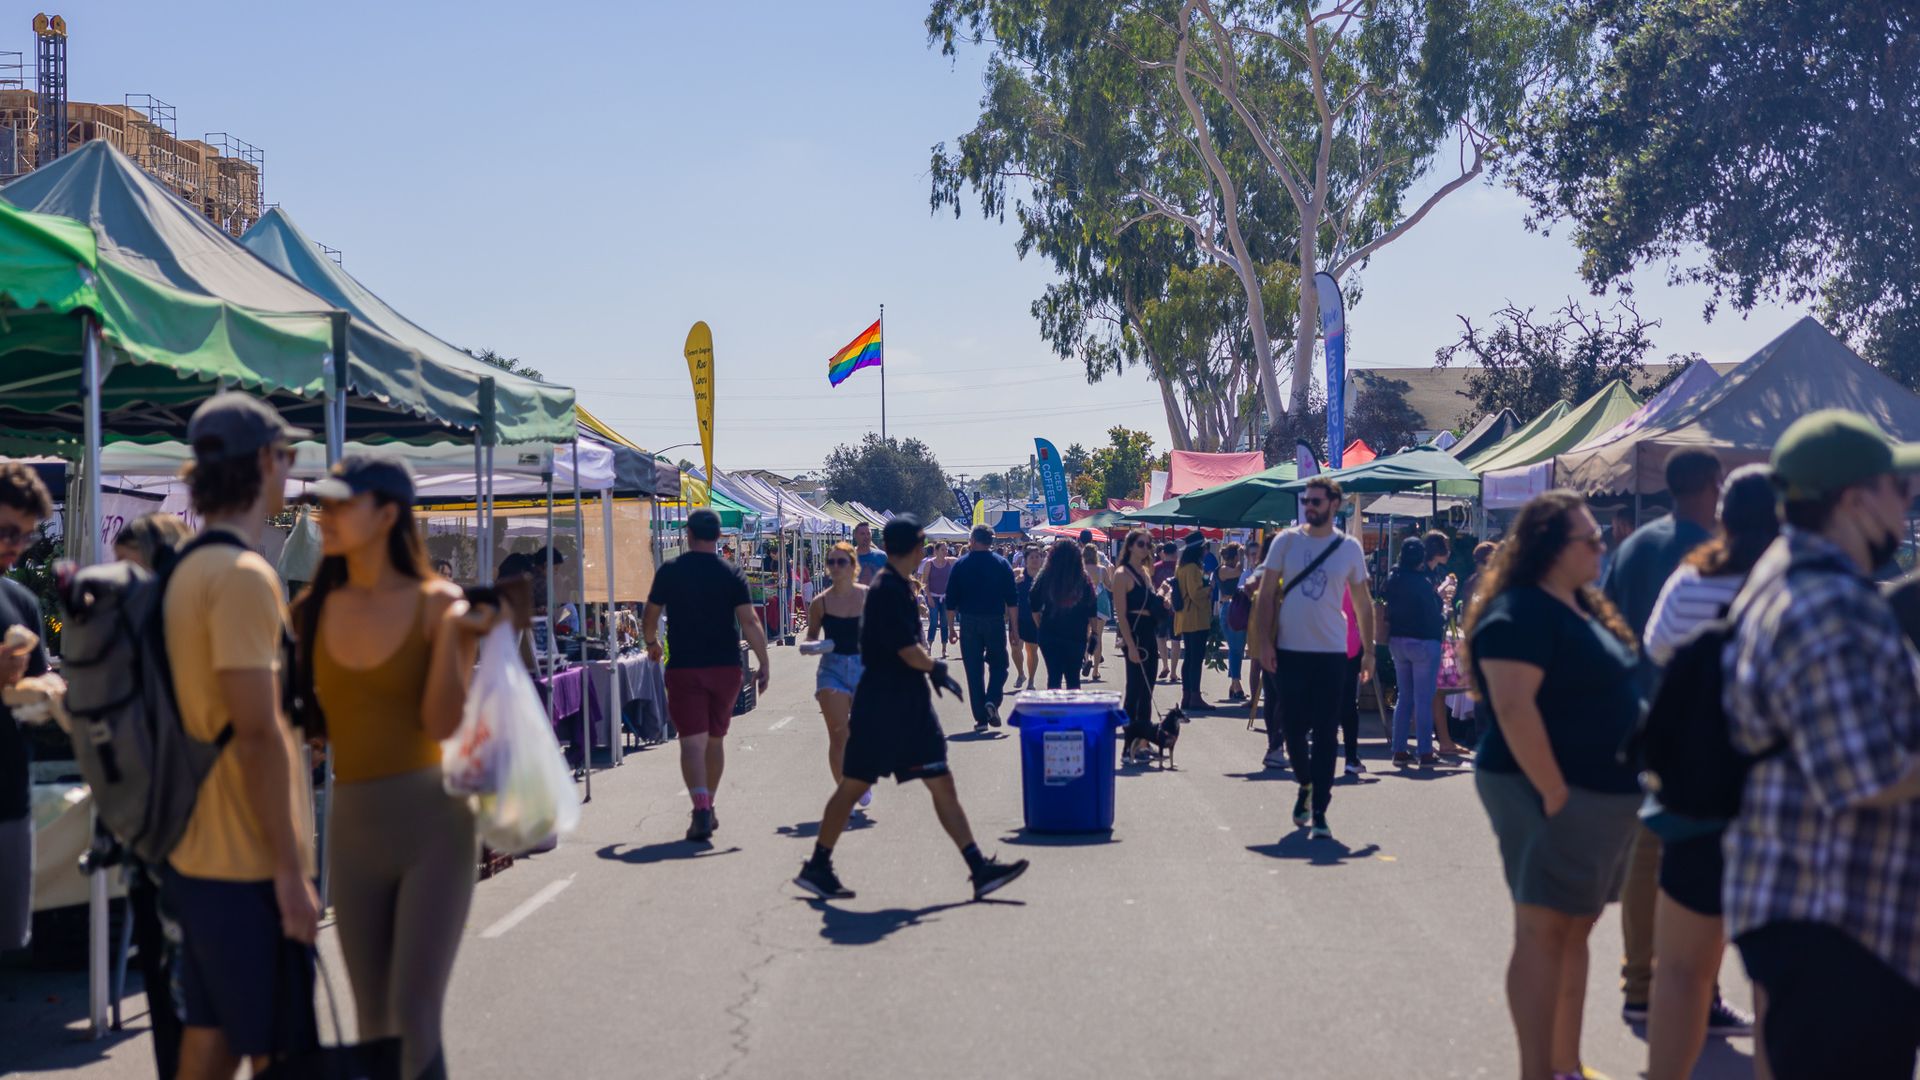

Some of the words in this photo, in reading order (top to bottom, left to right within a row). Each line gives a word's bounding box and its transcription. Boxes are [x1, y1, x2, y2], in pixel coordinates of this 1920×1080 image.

[1329, 349, 1339, 426] CREAM
[1042, 463, 1056, 502] COFFEE
[1054, 471, 1063, 492] ICED
